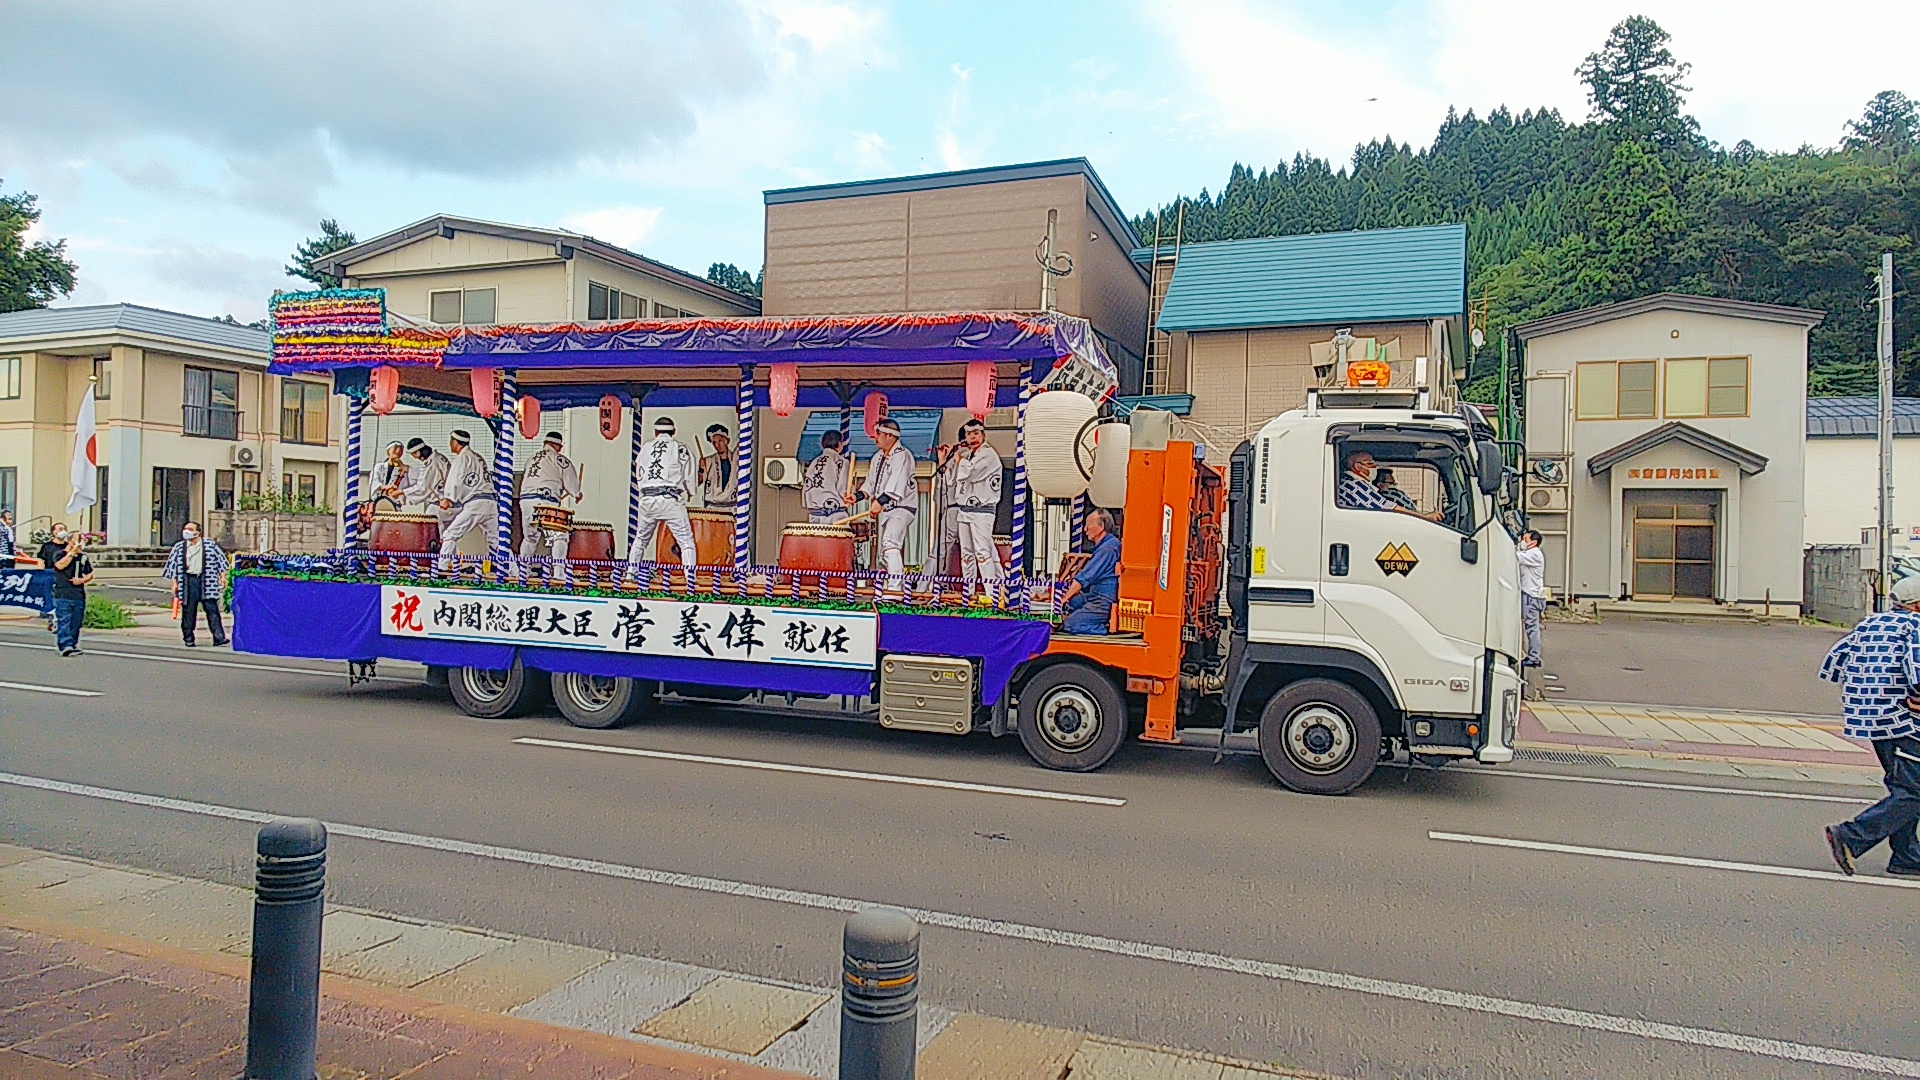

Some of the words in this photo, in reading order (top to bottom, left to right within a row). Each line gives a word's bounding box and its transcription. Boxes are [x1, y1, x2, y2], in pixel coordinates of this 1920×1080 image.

[647, 440, 670, 481] 佐竹太鼓
[1383, 561, 1410, 571] DEWA
[390, 589, 424, 632] 祝
[433, 599, 599, 638] 内閣総理大臣
[611, 601, 766, 659] 菅義偉
[782, 620, 851, 655] 就任
[1403, 678, 1447, 687] GIGA
